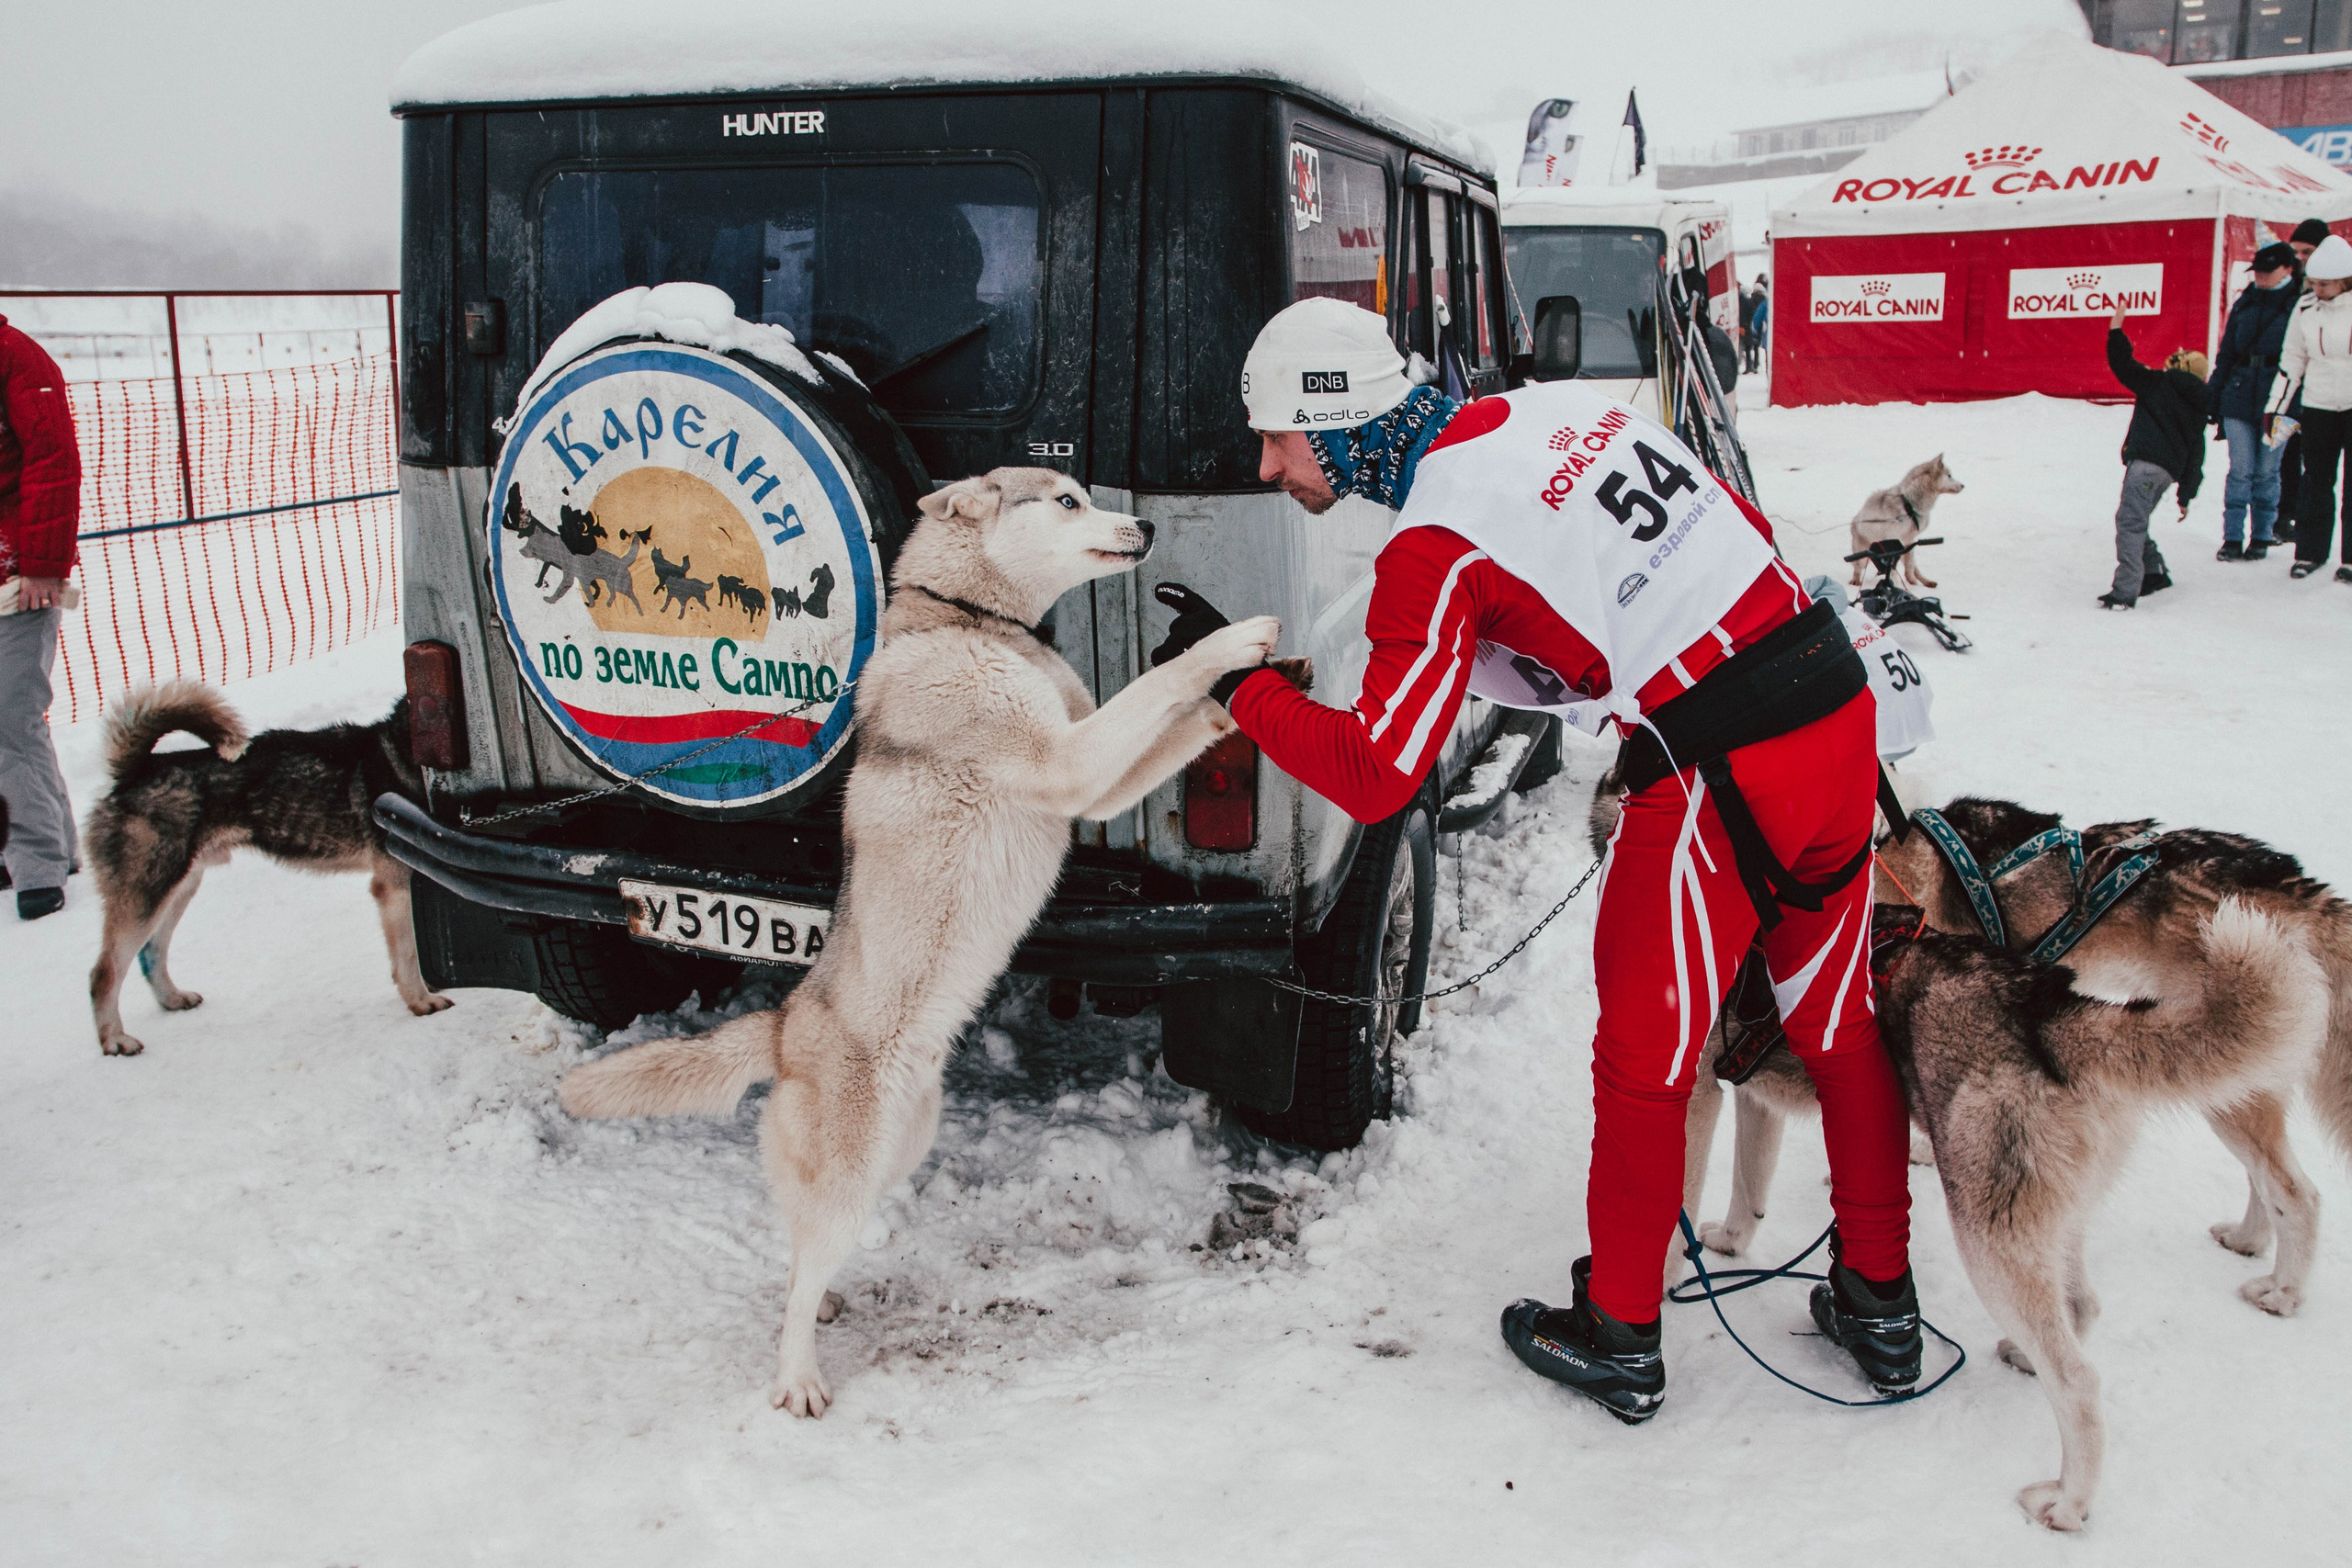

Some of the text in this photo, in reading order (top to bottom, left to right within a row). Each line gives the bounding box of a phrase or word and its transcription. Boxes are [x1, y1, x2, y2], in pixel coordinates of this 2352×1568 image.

[723, 111, 825, 137] HUNTER
[1832, 175, 1975, 203] ROYAL
[1992, 156, 2160, 194] CANIN
[1815, 299, 1939, 317] ROYAL CANIN
[2013, 290, 2156, 313] ROYAL CANIN
[1306, 372, 1345, 393] DNB
[1313, 410, 1370, 422] odlo
[1027, 443, 1074, 457] 3.0
[1541, 407, 1633, 512] ROYAL CANIN
[1594, 440, 1700, 542] 54
[1649, 500, 1707, 570] ездовой
[540, 637, 838, 704] по земле Сампо
[1880, 649, 1921, 692] 50
[1531, 1337, 1589, 1370] SALOMON
